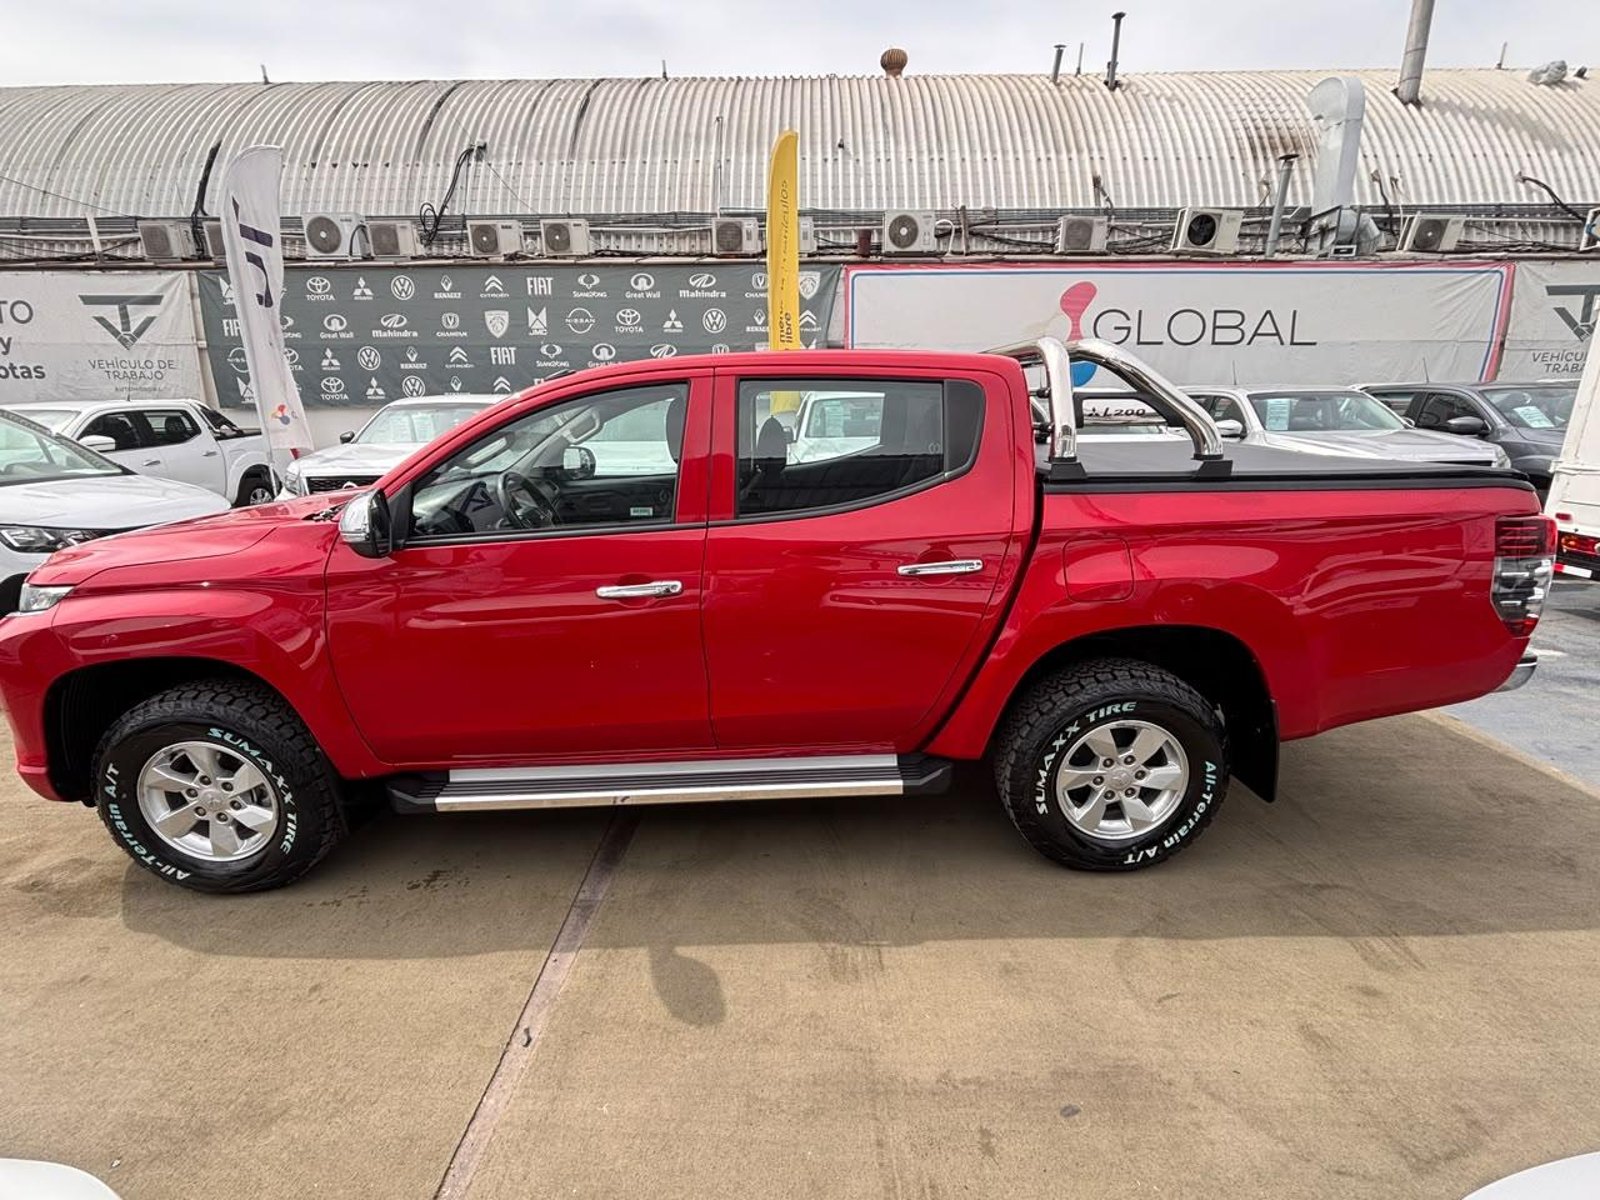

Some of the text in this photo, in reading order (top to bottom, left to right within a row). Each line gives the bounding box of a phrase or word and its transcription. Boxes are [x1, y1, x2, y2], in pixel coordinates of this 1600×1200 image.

[526, 276, 553, 296] FIAT
[679, 289, 727, 298] Mahindra
[625, 291, 661, 299] Great Wall
[320, 331, 354, 339] Great Wall
[372, 330, 418, 338] Mahindra
[615, 325, 644, 333] TOYOTA
[784, 311, 794, 344] libre
[1093, 309, 1318, 345] GLOBAL
[88, 356, 176, 370] VEHÍCULO DE
[490, 346, 517, 365] FIAT
[105, 369, 164, 381] TRABAJO
[1104, 407, 1146, 416] L200
[1035, 701, 1137, 815] SUMAXX TIRE
[207, 727, 298, 856] SUMAXX TIRE
[1123, 760, 1218, 864] All-Terrain A/T
[104, 762, 192, 881] All-Terrain A/T
